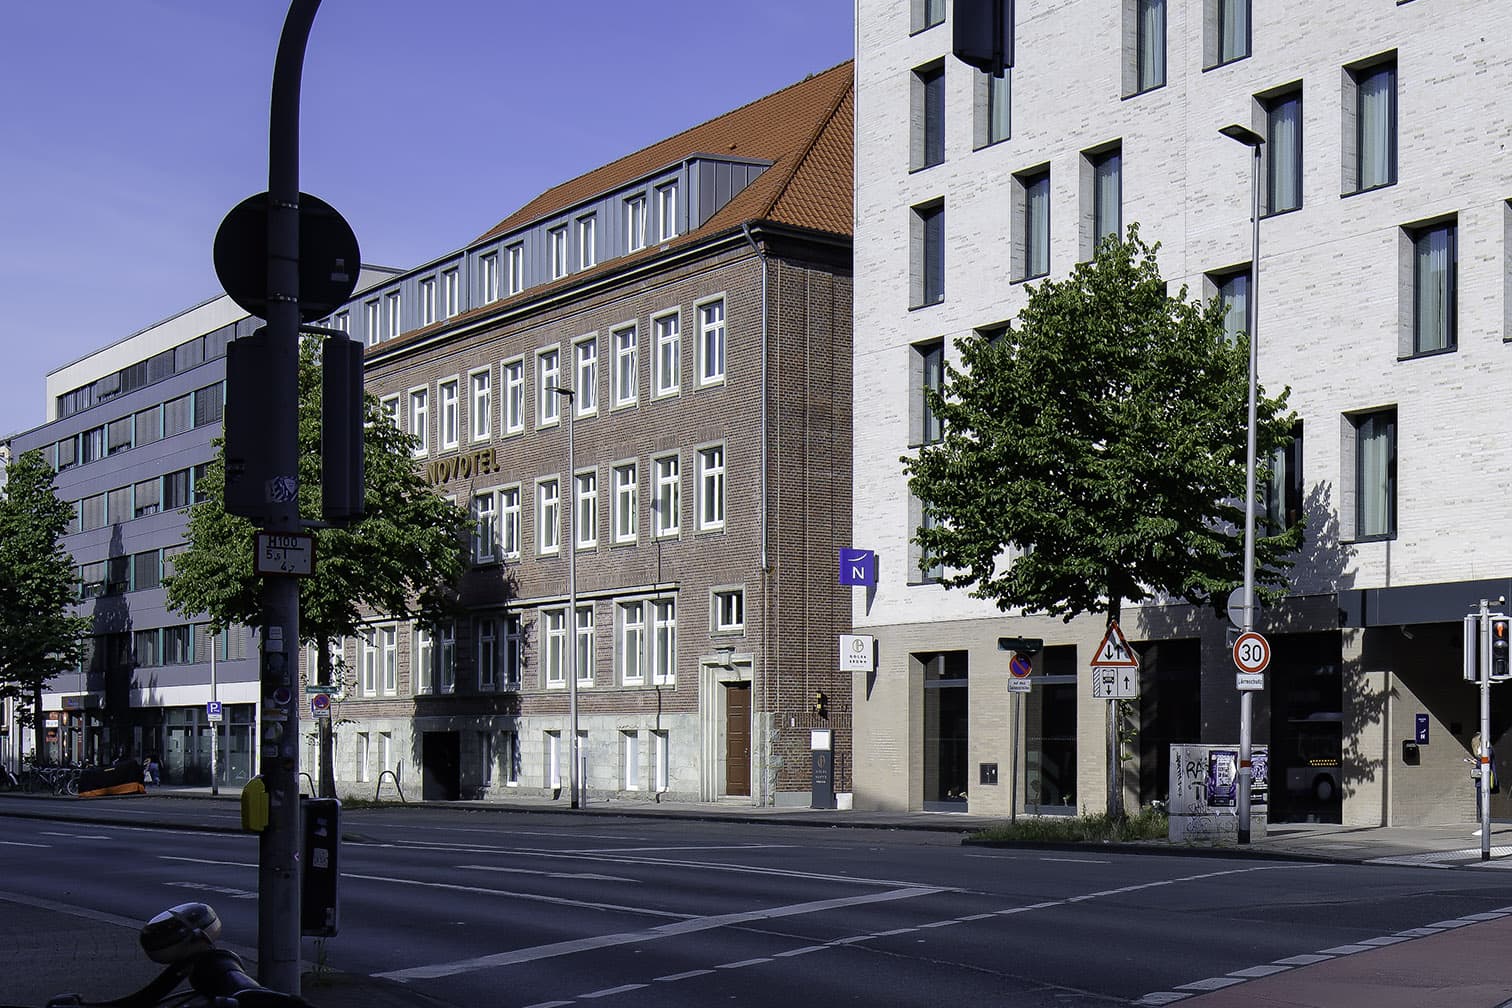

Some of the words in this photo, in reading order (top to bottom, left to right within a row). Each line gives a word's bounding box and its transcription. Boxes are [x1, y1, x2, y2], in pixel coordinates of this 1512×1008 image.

[426, 447, 501, 485] NOVOTEL
[268, 535, 298, 547] H100
[852, 566, 865, 579] N
[1241, 644, 1262, 662] 30
[210, 703, 218, 713] P
